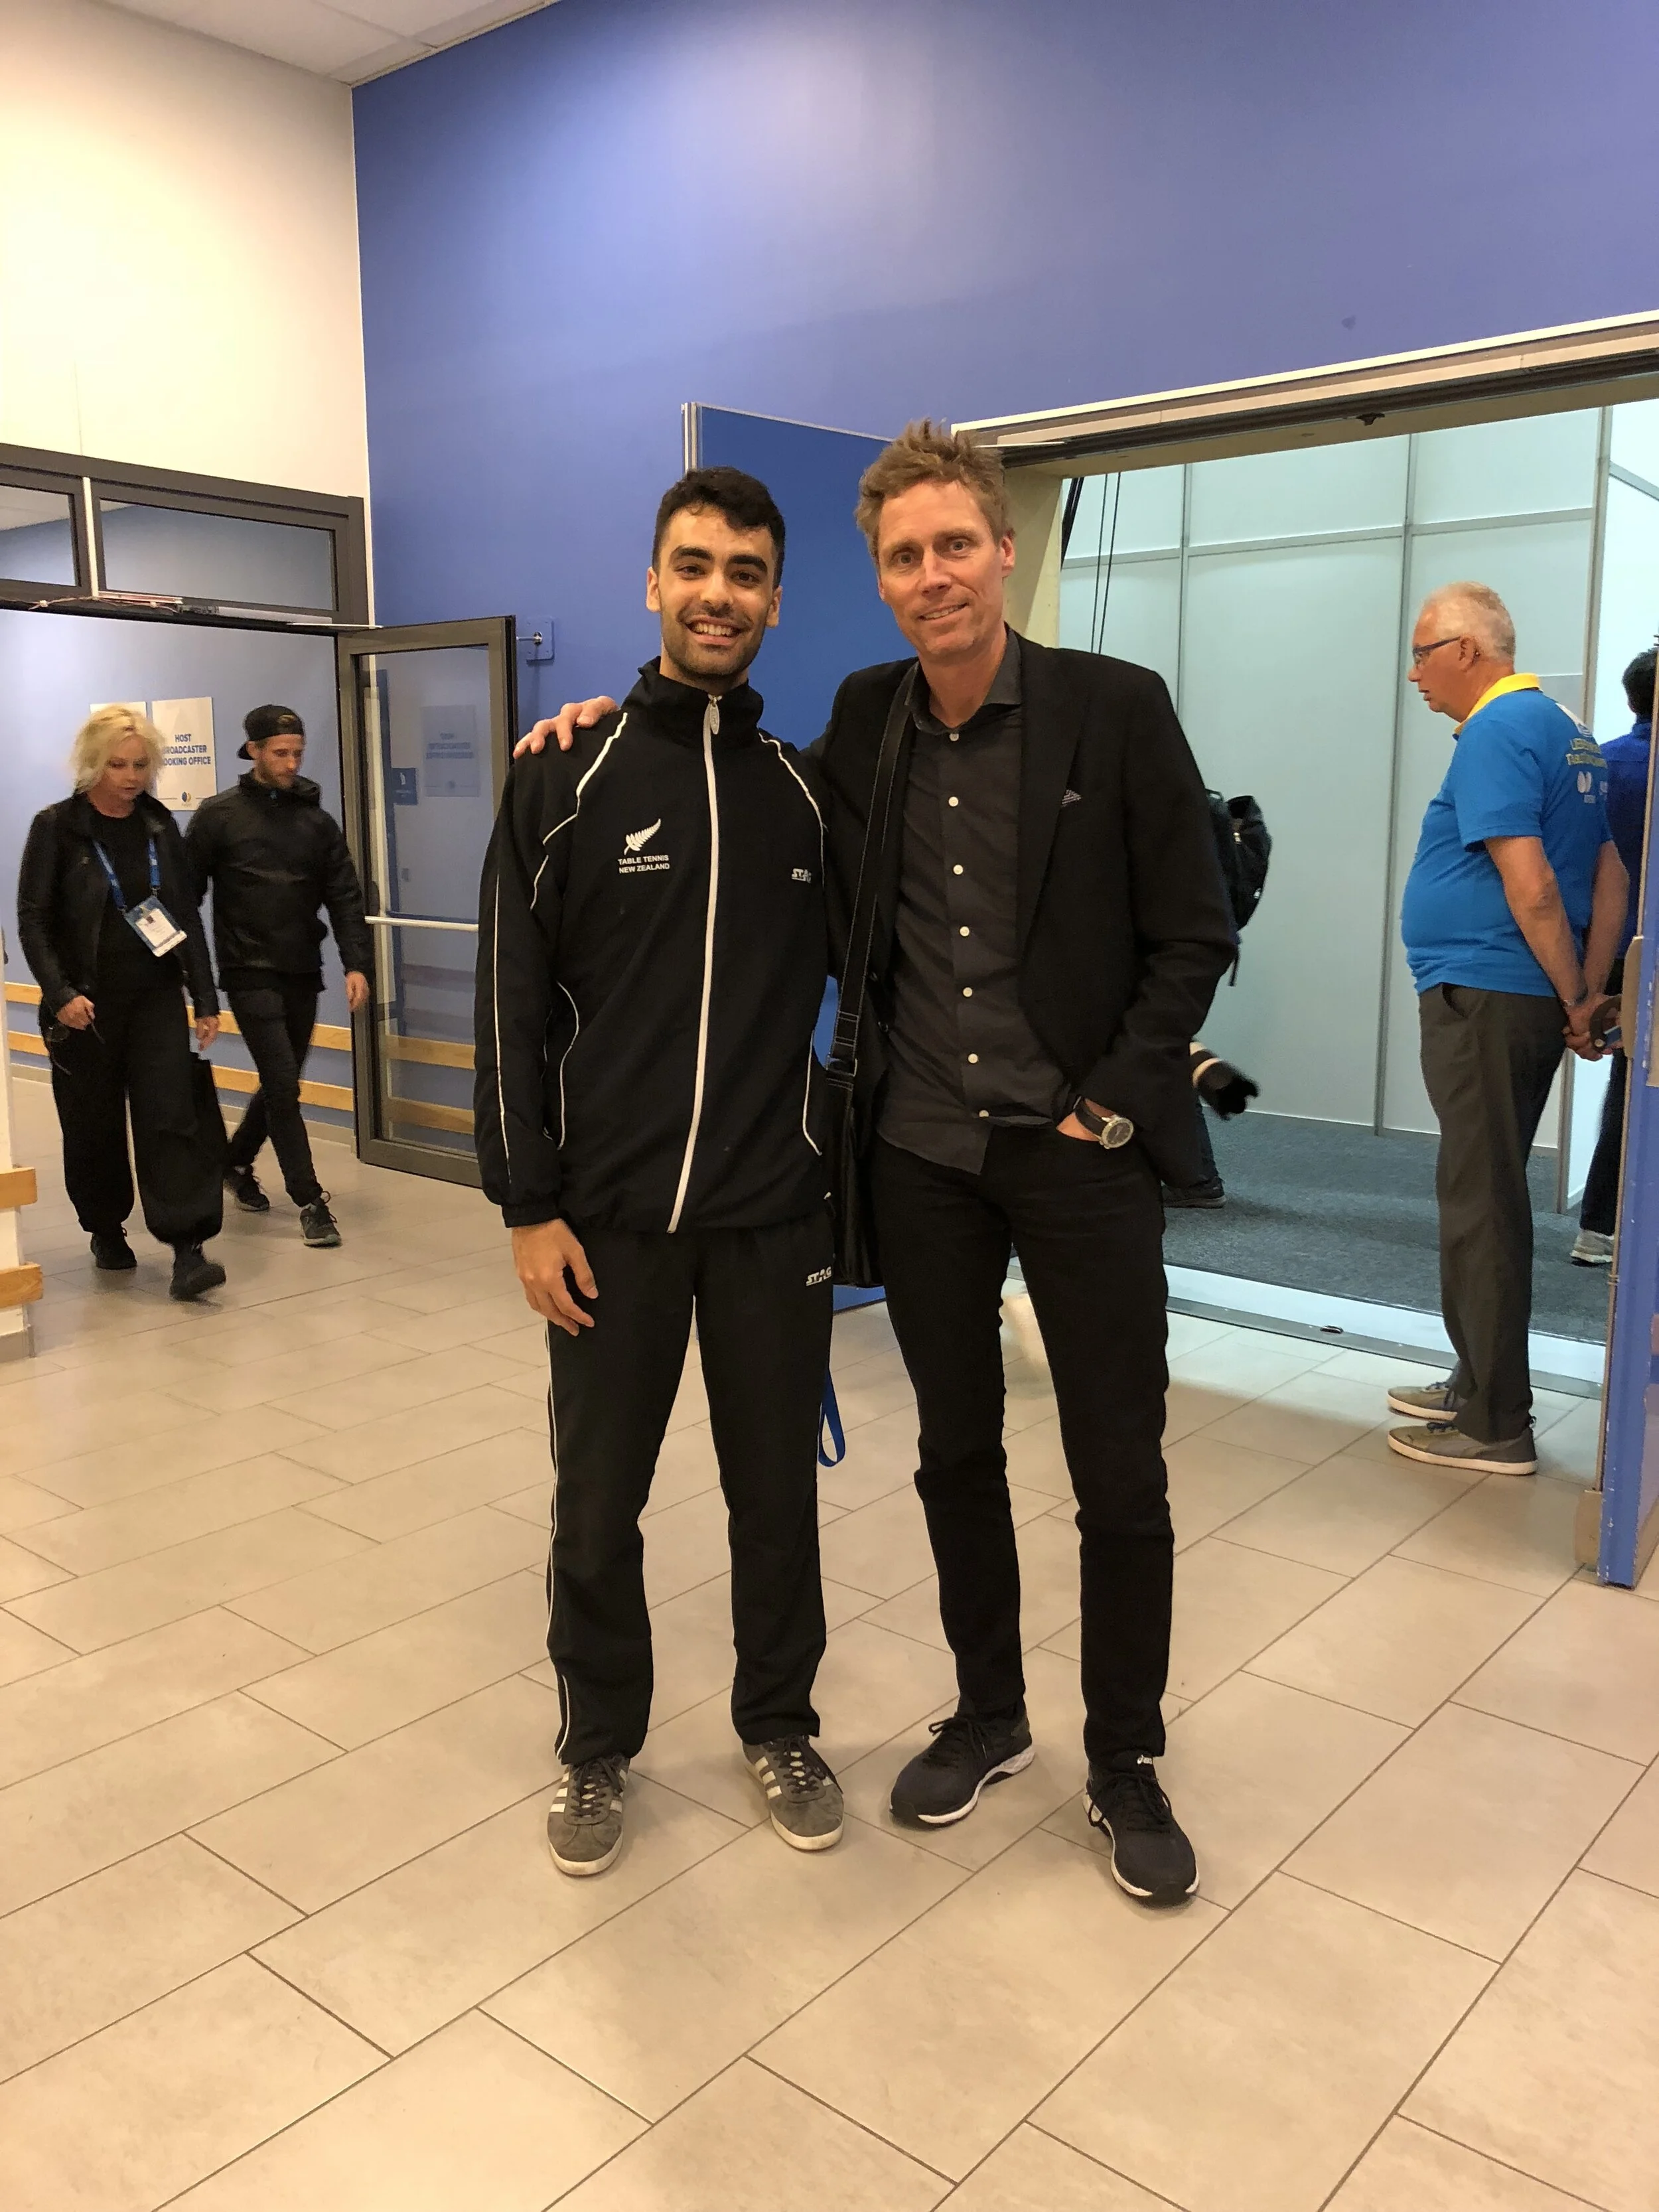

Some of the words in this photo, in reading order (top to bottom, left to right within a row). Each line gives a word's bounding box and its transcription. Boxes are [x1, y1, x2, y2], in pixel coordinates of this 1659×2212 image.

[175, 733, 191, 742] HOST
[163, 745, 207, 754] ROADCASTER
[163, 757, 187, 766] OOKING
[806, 1266, 831, 1286] STAG
